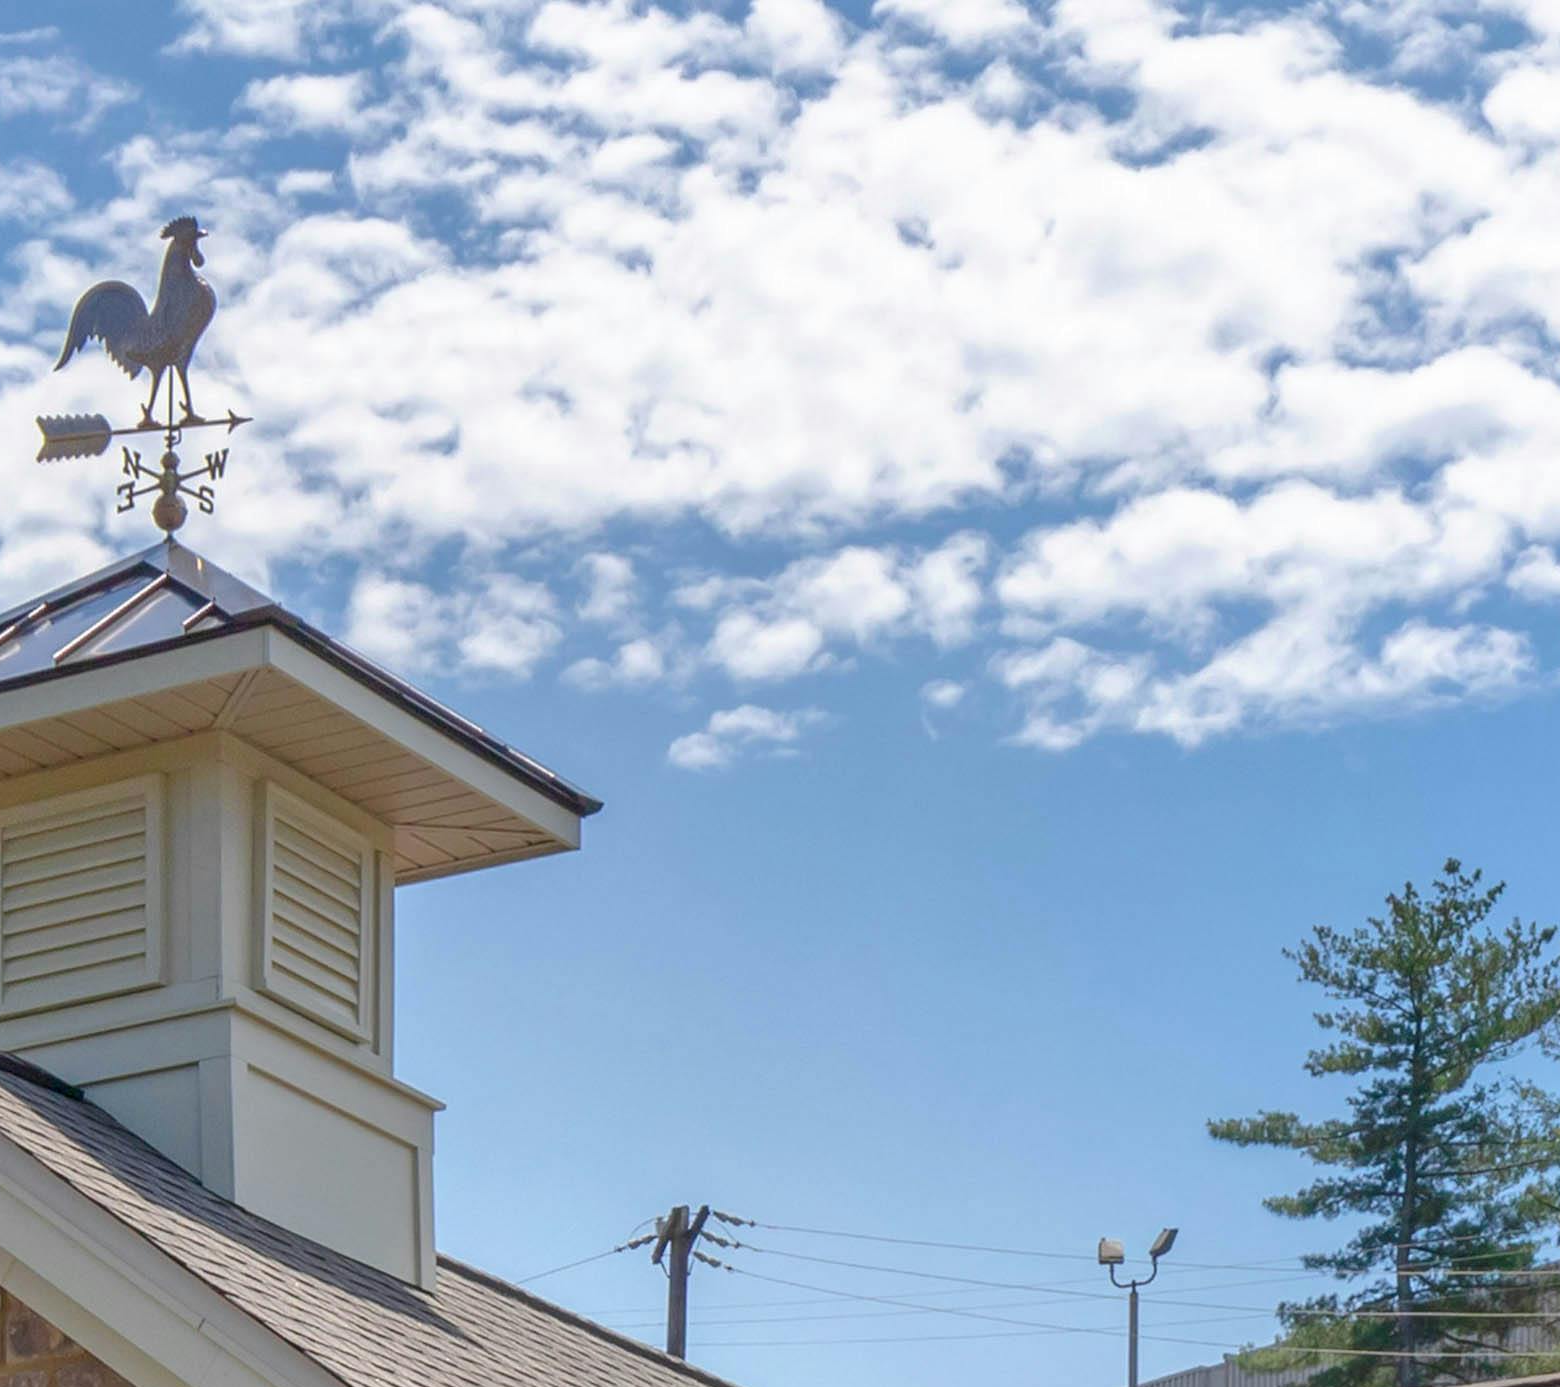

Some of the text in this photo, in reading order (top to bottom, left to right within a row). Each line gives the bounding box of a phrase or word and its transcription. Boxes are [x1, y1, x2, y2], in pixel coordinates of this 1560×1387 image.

[122, 446, 141, 479] N
[205, 447, 229, 480] W
[199, 485, 214, 514] S
